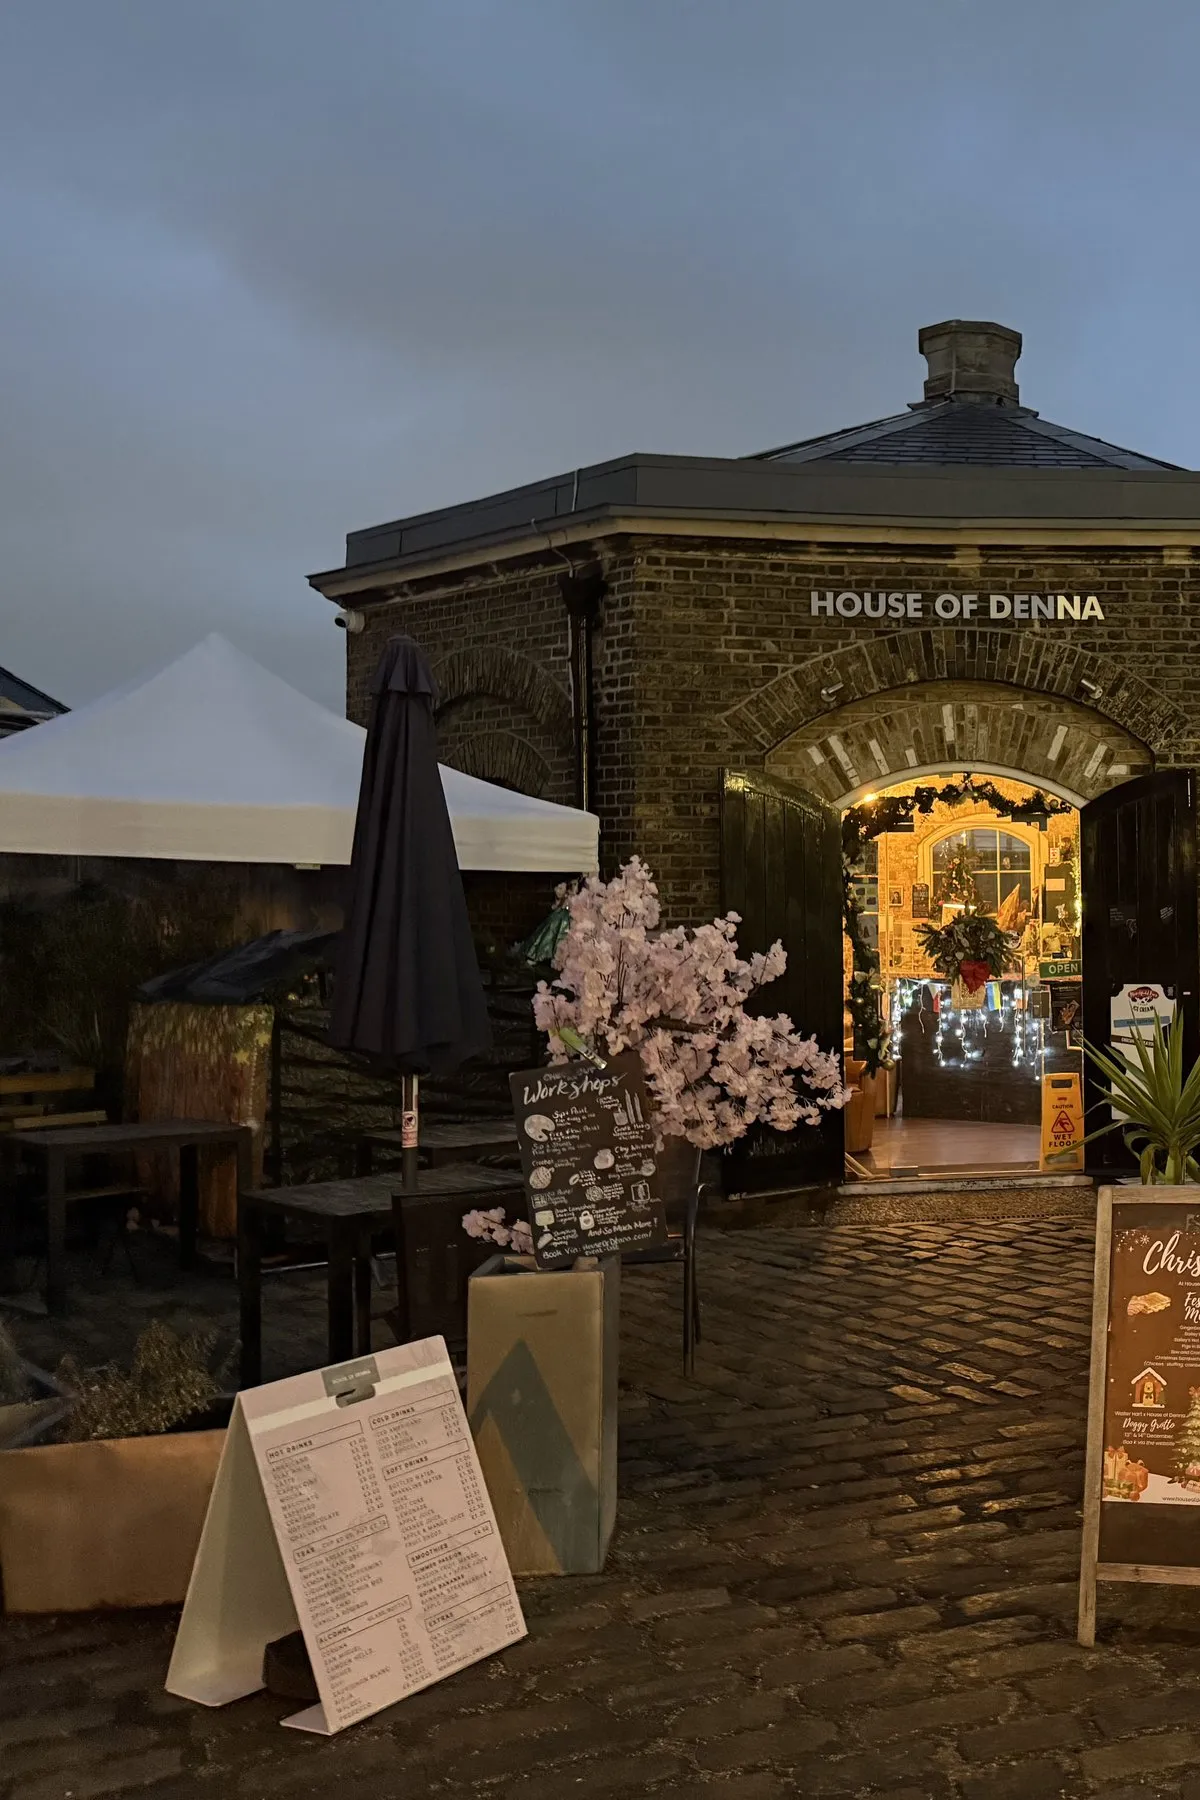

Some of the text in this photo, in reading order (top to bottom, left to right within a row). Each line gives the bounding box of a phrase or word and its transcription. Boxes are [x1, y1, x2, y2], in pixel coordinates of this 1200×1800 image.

[810, 591, 1105, 620] HOUSE OF DENNA
[1049, 963, 1078, 974] OPEN
[523, 1073, 629, 1105] Workshops
[587, 1228, 602, 1237] And
[541, 1248, 562, 1260] Book
[371, 1406, 415, 1425] COLD DRINKS
[1122, 1417, 1175, 1433] Doggy Grotto
[268, 1439, 313, 1458] HOT DRINKS
[385, 1455, 428, 1475] SOFT DRINKS
[410, 1542, 448, 1562] SMOOTHIES
[412, 1550, 462, 1576] SUMMER PASSION
[437, 1572, 465, 1589] BANANAS
[427, 1610, 454, 1627] EXTRAS
[318, 1624, 351, 1644] ALCOHOL
